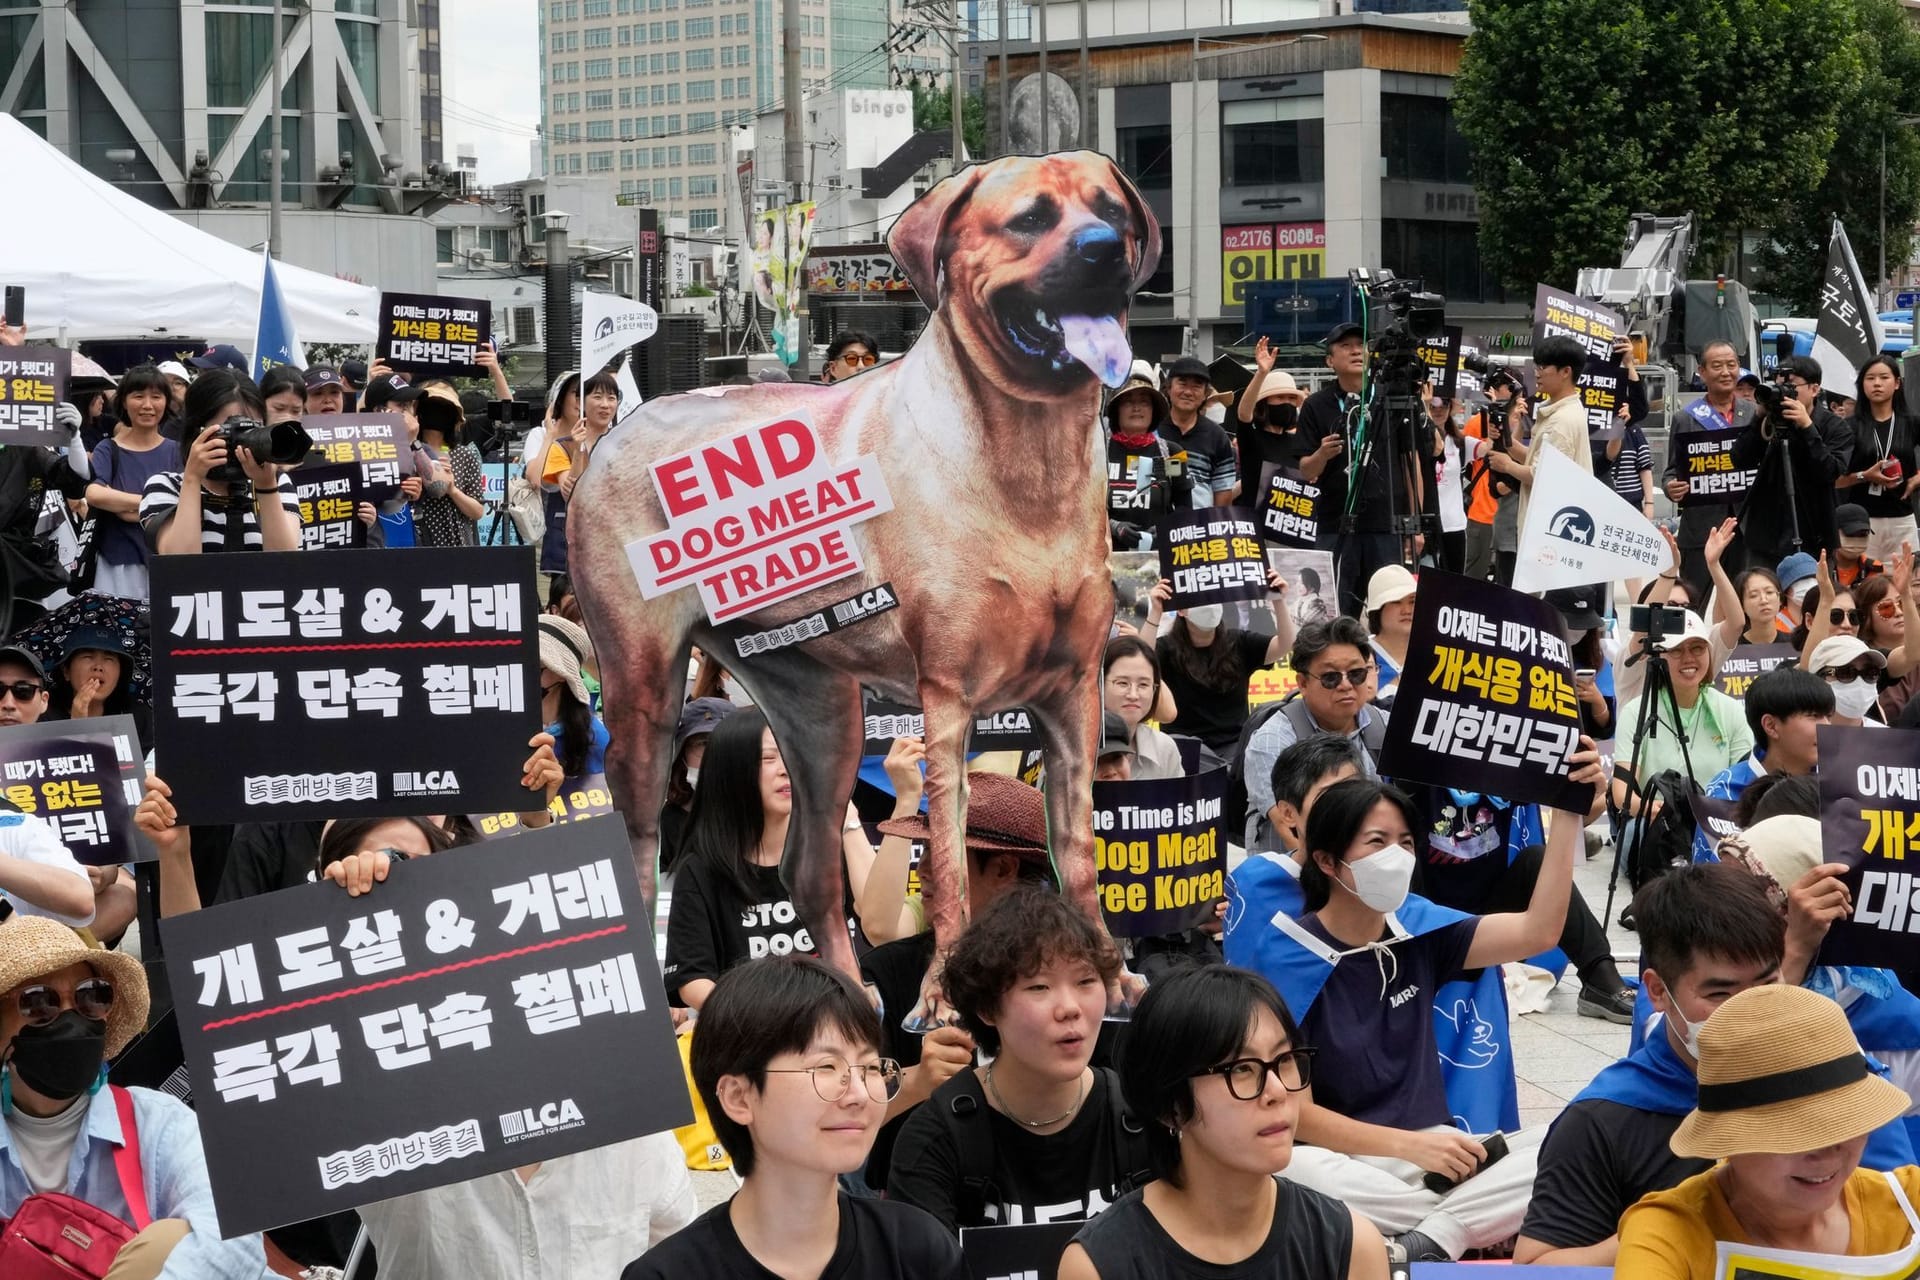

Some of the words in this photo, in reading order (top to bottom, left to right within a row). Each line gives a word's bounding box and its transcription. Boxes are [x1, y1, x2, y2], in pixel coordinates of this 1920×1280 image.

[851, 97, 907, 117] bingo
[392, 305, 426, 319] 이제는
[428, 308, 451, 320] 때가
[453, 309, 478, 322] 됐다!
[1546, 307, 1587, 332] 개식용
[1589, 321, 1615, 341] 없는
[392, 320, 441, 340] 개식용
[445, 323, 478, 342] 없는
[390, 340, 477, 365] 대한민국!
[21, 361, 55, 376] 됐다!
[12, 379, 55, 402] 없는
[1585, 388, 1615, 408] 없는
[334, 426, 361, 439] 때가
[363, 425, 393, 439] 됐다!
[358, 440, 398, 460] 없는
[1687, 442, 1720, 454] 이제는
[655, 419, 817, 518] END
[323, 478, 351, 495] 됐다!
[1272, 475, 1302, 494] 이제는
[317, 498, 353, 521] 없는
[1269, 489, 1314, 517] 개식용
[649, 515, 745, 573] DOG
[748, 468, 862, 537] MEAT
[1169, 524, 1206, 543] 이제는
[1208, 520, 1235, 536] 때가
[1172, 538, 1228, 566] 개식용
[1231, 537, 1262, 559] 없는
[1599, 539, 1659, 567] 보호단체연합
[1603, 524, 1661, 553] 전국길고양이
[703, 530, 849, 606] TRADE
[1173, 562, 1267, 593] 대한민국!
[170, 591, 224, 641] 개
[238, 587, 344, 638] 도살
[361, 587, 404, 634] &
[421, 583, 522, 634] 거래
[851, 586, 894, 616] LCA
[739, 617, 825, 654] 동물해방물결
[1437, 605, 1498, 647] 이제는
[1501, 620, 1538, 657] 때가
[1540, 630, 1571, 669] 됐다!
[1722, 658, 1758, 673] 이제는
[172, 671, 279, 724] 즉각
[297, 667, 404, 721] 단속
[423, 663, 526, 715] 철폐
[1428, 645, 1522, 705] 개식용
[1529, 665, 1578, 719] 없는
[993, 712, 1031, 730] LCA
[1411, 698, 1581, 776] 대한민국!
[4, 758, 46, 780] 때가
[48, 754, 95, 776] 됐다!
[413, 770, 460, 791] LCA
[41, 780, 102, 810] 없는
[249, 775, 374, 800] 동물해방물결
[1857, 764, 1920, 800] 이제
[1118, 806, 1174, 830] Time
[1177, 802, 1194, 826] is
[1196, 797, 1222, 823] Now
[1094, 836, 1150, 875] Dog
[1157, 826, 1217, 869] Meat
[1154, 869, 1223, 911] Korea
[741, 900, 796, 928] STO
[193, 942, 264, 1007] 개
[276, 909, 406, 992] 도살
[424, 898, 476, 955] &
[492, 858, 624, 936] 거래
[748, 928, 816, 960] DOG
[213, 1023, 342, 1103] 즉각
[359, 990, 493, 1070] 단속
[511, 952, 646, 1035] 철폐
[522, 1098, 584, 1132] LCA
[504, 1136, 520, 1145] LAST
[520, 1131, 546, 1141] CHANCE
[546, 1128, 559, 1136] FOR
[559, 1119, 586, 1131] ANIMALS
[325, 1123, 480, 1183] 동물해방물결
